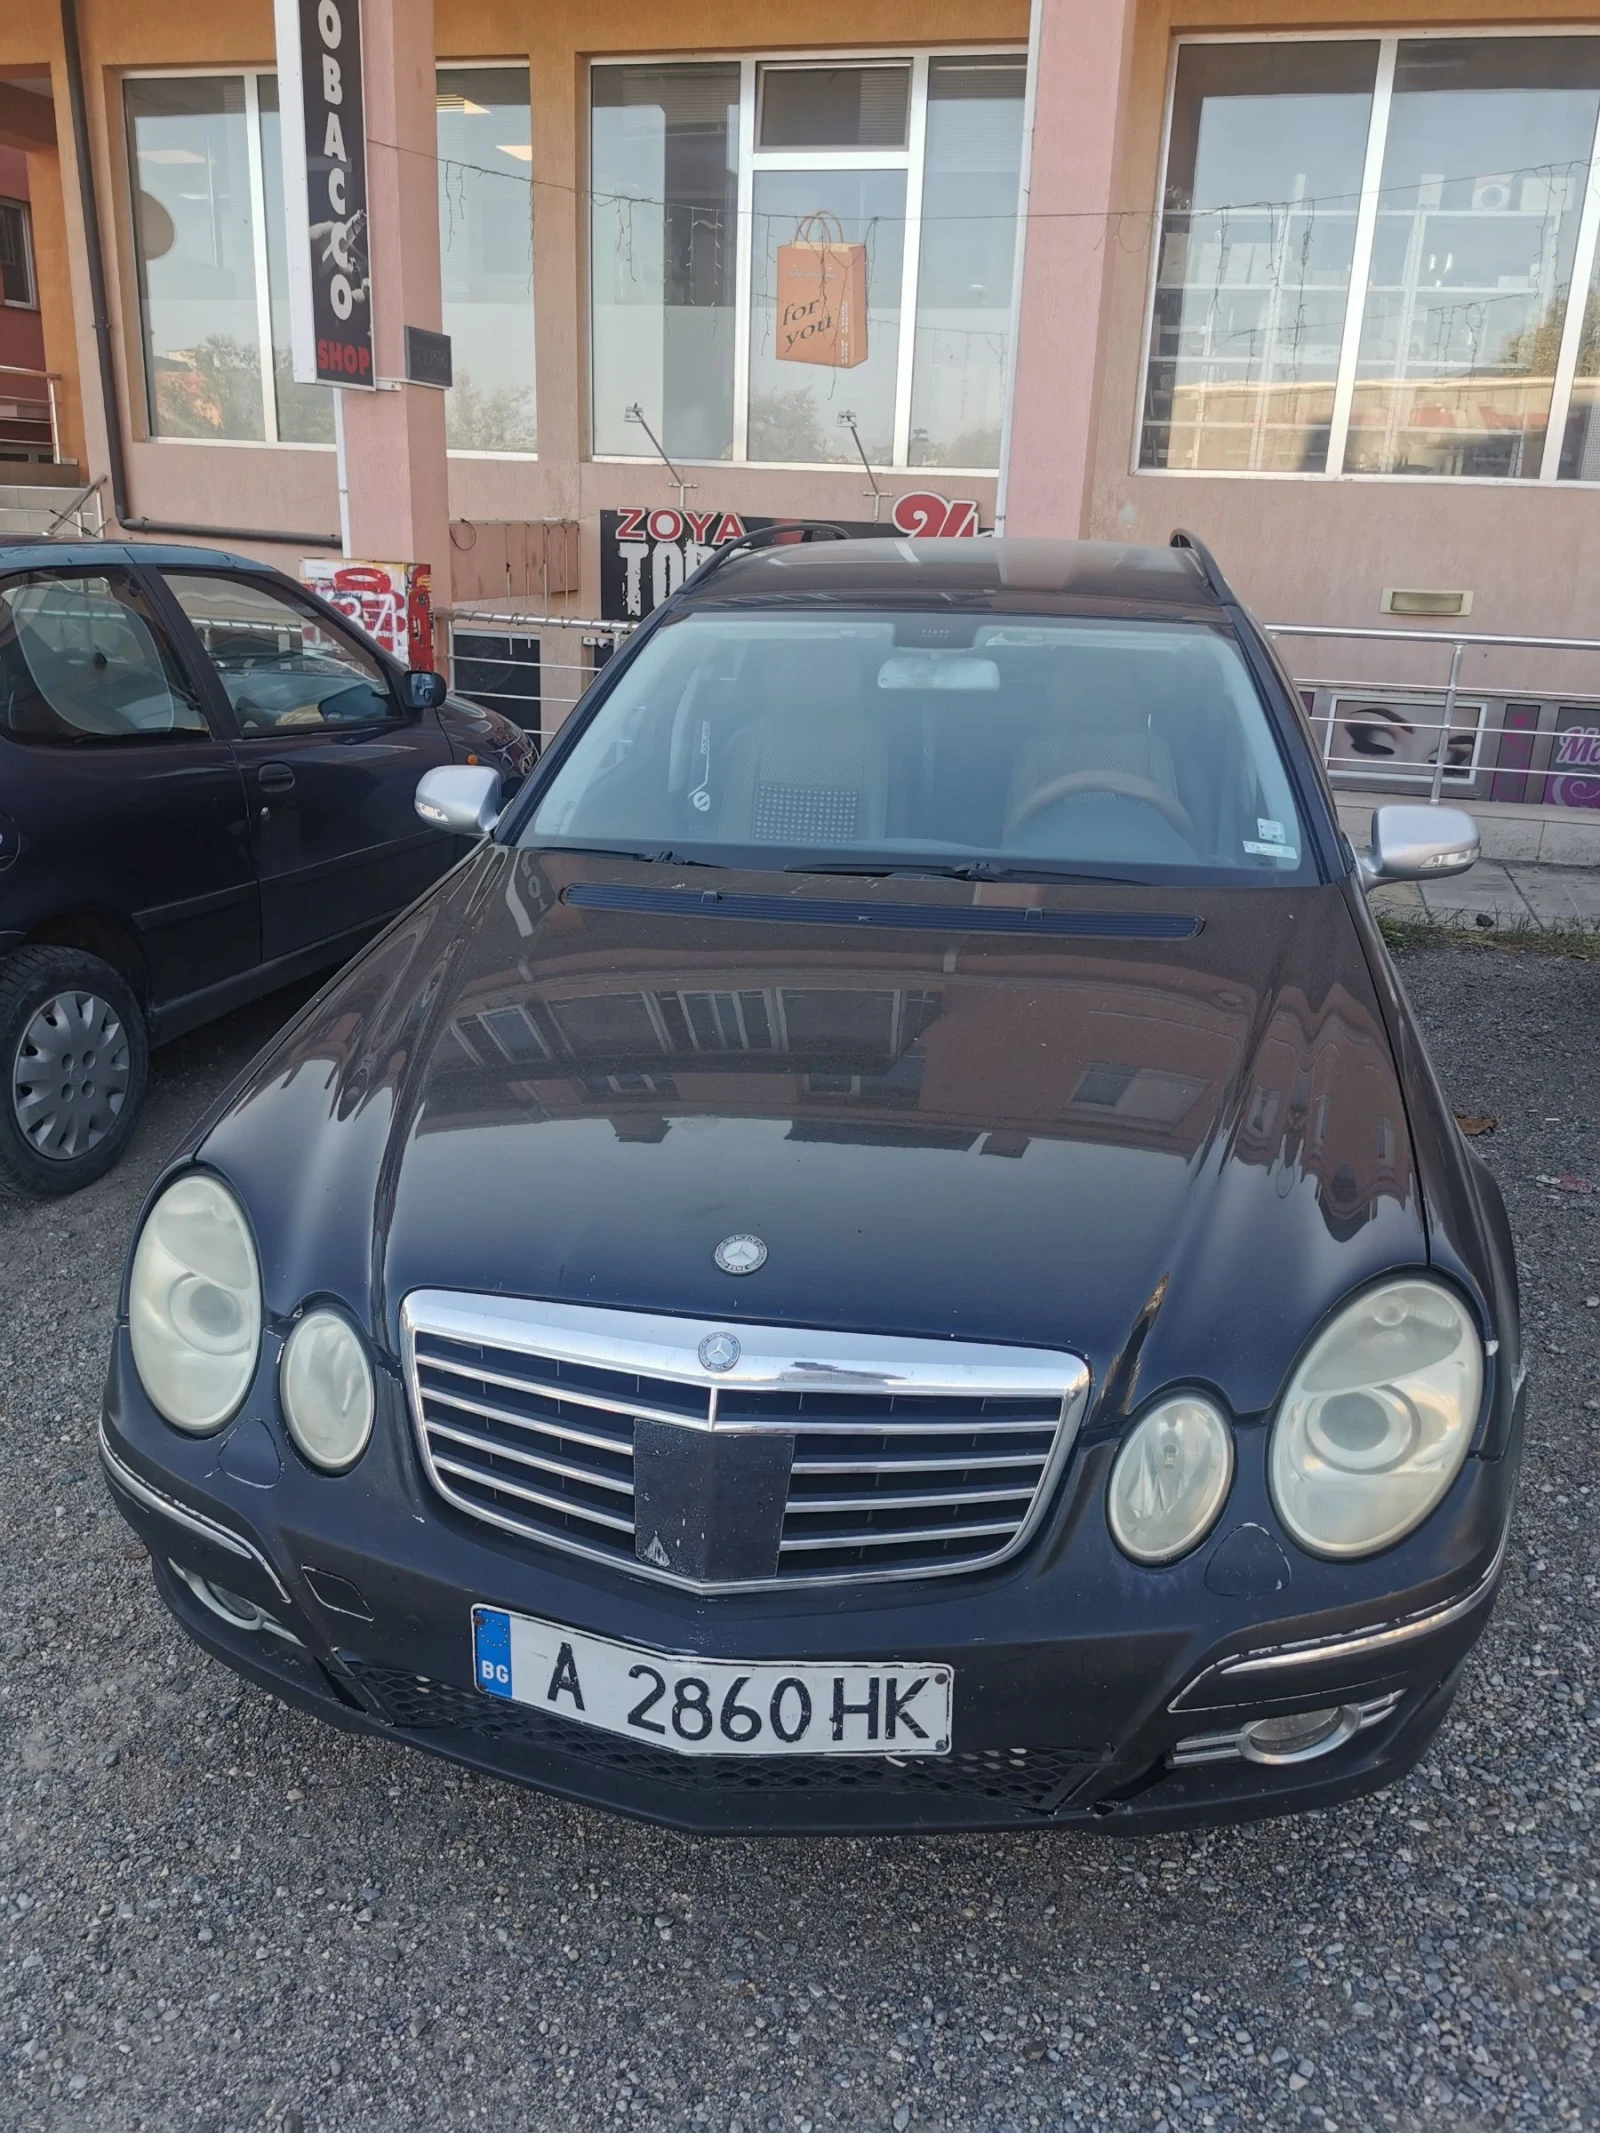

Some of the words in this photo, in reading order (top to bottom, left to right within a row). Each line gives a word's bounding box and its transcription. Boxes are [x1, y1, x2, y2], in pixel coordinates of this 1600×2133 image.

[782, 298, 820, 327] for
[784, 315, 832, 353] you
[318, 338, 370, 376] SHOP
[616, 507, 750, 546] ZOYA
[480, 1660, 509, 1683] BG
[547, 1642, 585, 1711] A
[627, 1663, 812, 1743] 2860
[829, 1676, 930, 1740] HK
